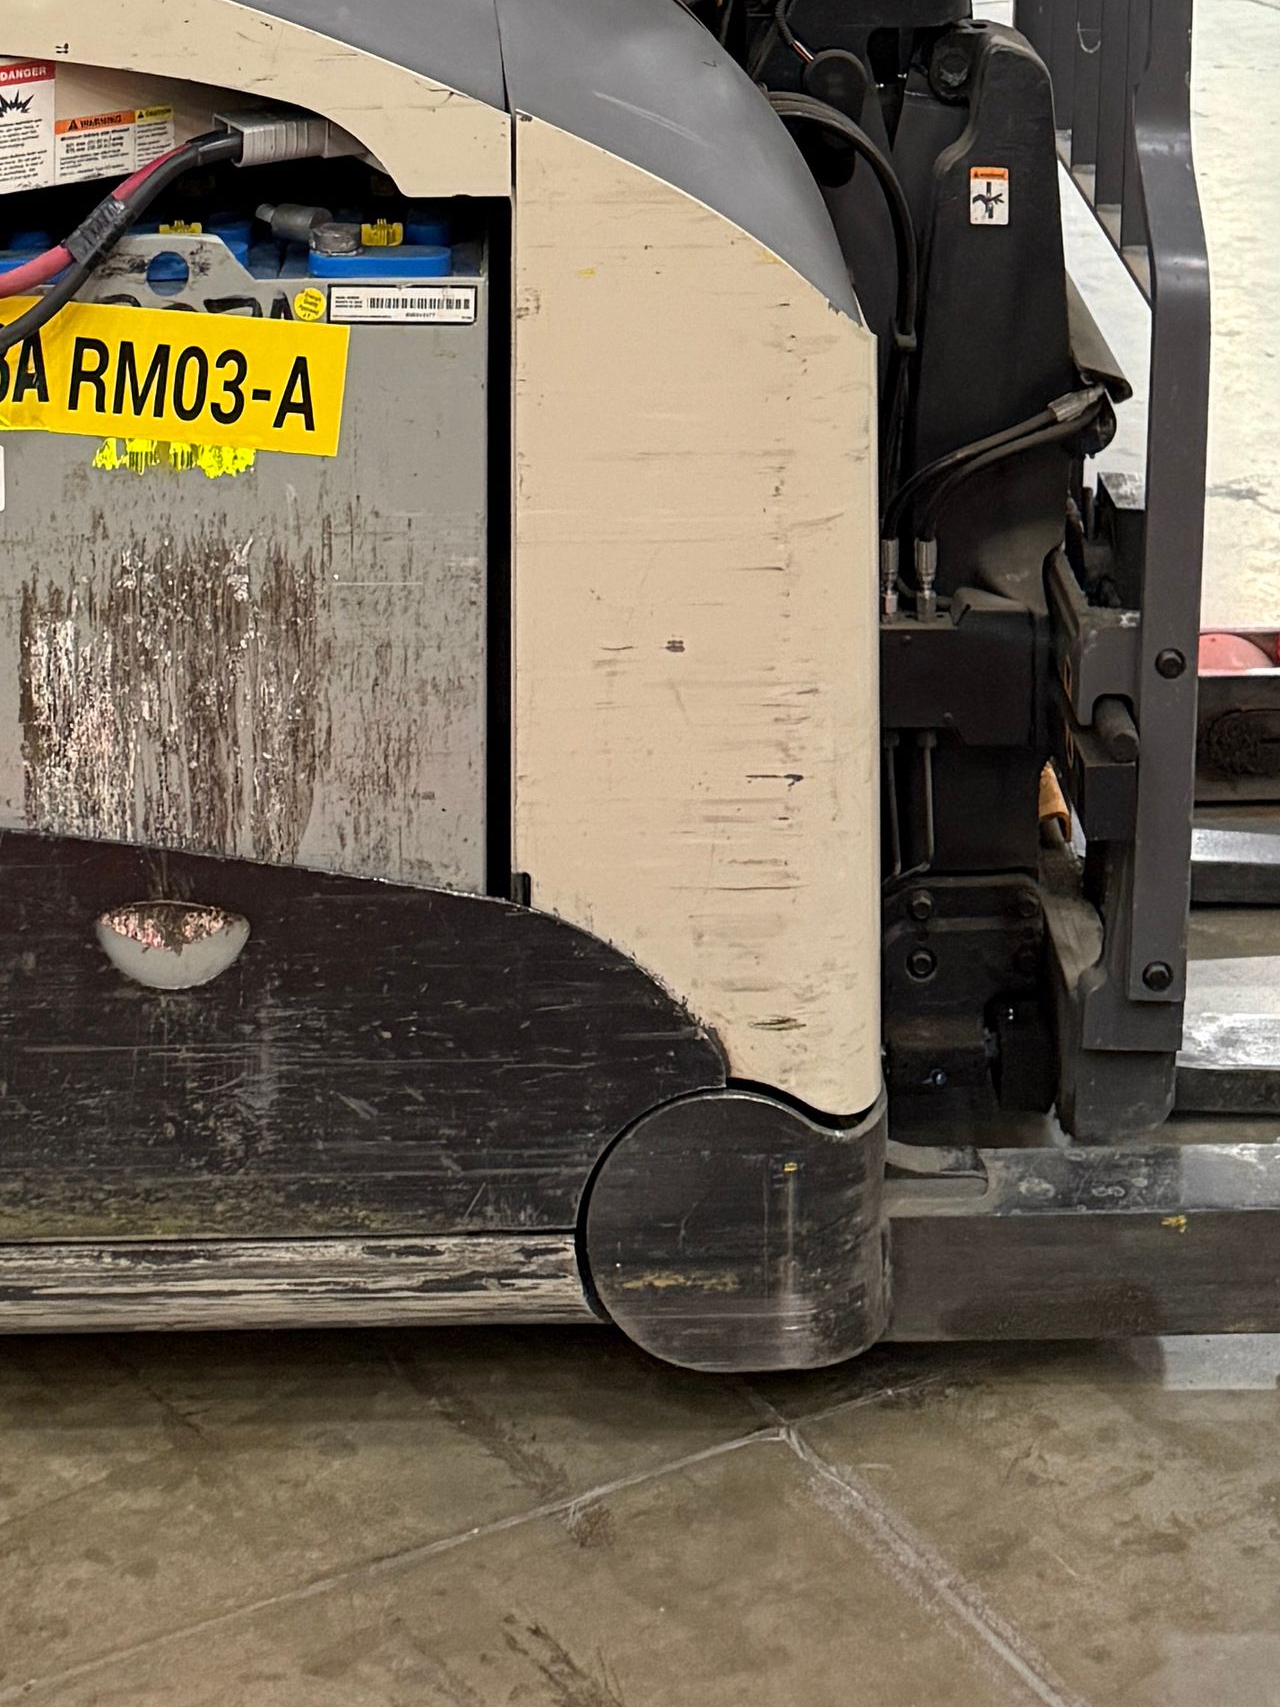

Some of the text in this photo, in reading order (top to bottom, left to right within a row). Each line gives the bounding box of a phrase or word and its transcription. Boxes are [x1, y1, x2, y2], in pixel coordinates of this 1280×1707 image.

[0, 67, 47, 82] DANGER
[80, 115, 122, 129] WARNING
[68, 336, 316, 432] RM03-A
